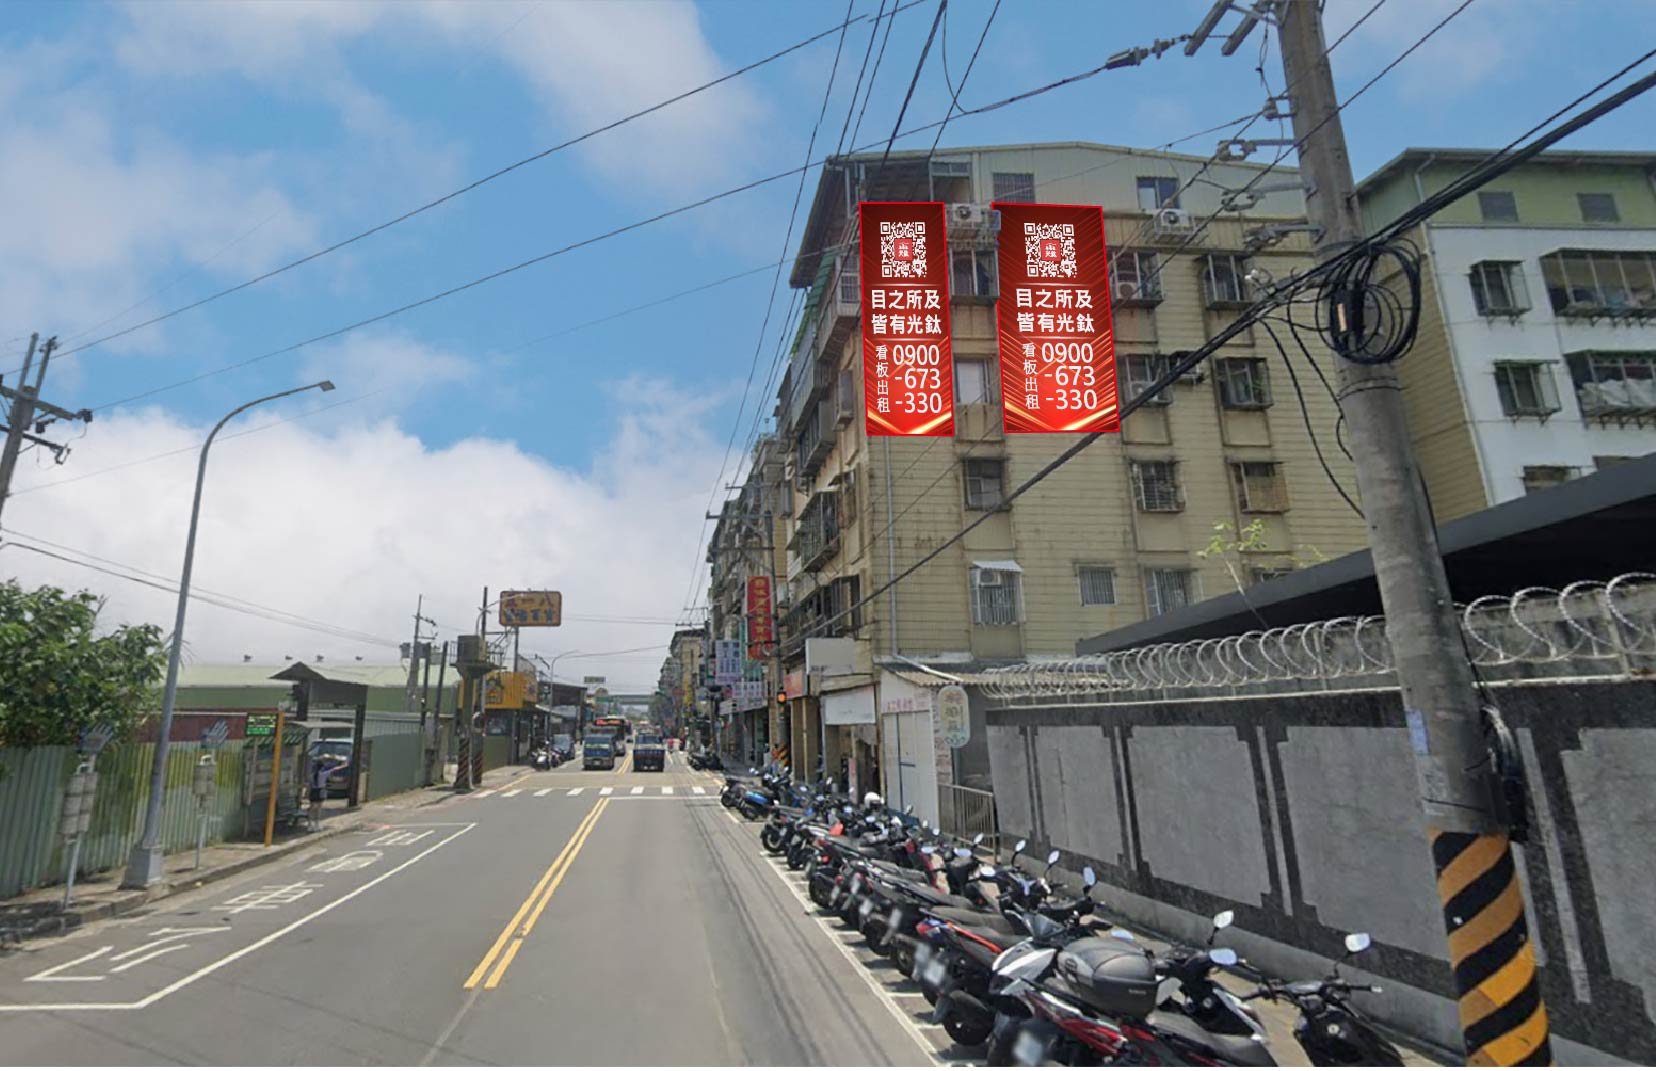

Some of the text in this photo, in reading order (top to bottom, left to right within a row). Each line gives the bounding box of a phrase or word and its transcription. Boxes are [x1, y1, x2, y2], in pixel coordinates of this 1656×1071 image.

[871, 289, 941, 309] 目之所及
[1016, 287, 1092, 308] 目之所及
[871, 314, 942, 335] 皆有光鈦
[1017, 311, 1095, 332] 皆有光鈦
[892, 344, 939, 365] 0900
[1041, 343, 1093, 363] 0900
[875, 344, 891, 413] 看板出租
[894, 369, 940, 389] -673
[1022, 343, 1040, 410] 看板出租
[1044, 365, 1095, 385] -673
[896, 392, 942, 413] -330
[1046, 389, 1098, 410] -330
